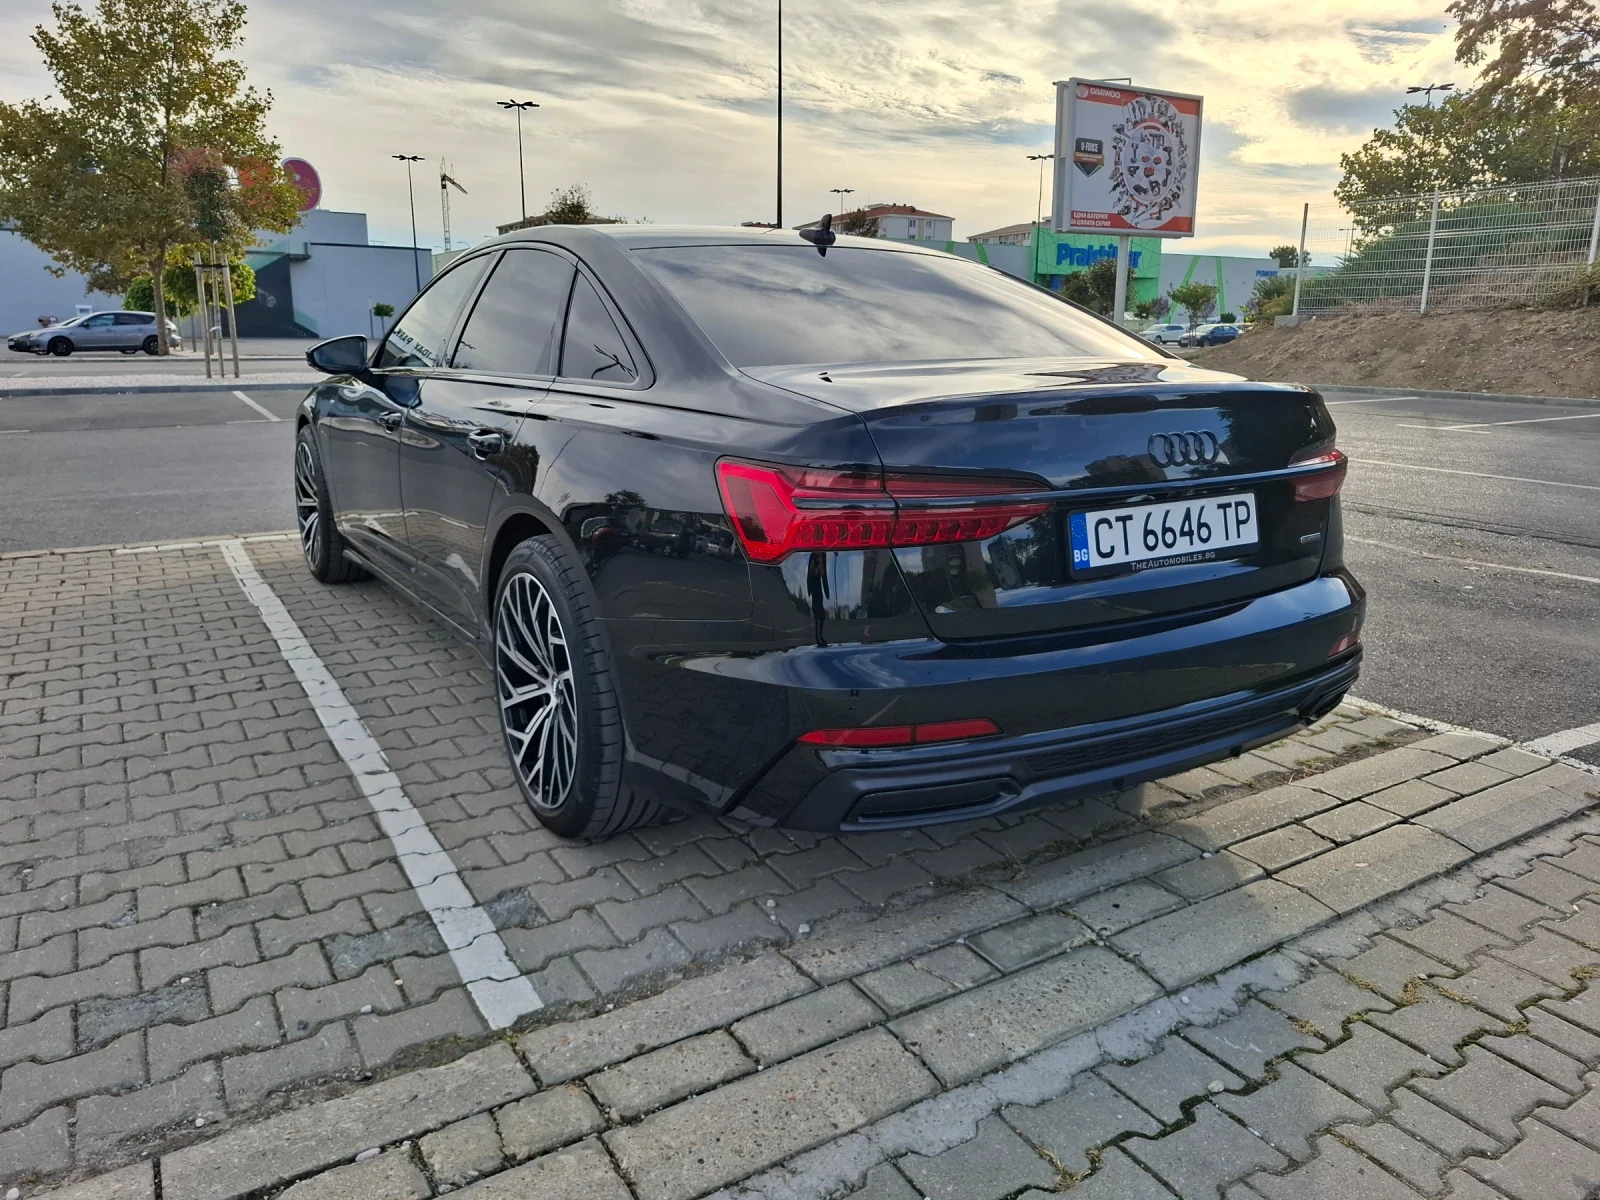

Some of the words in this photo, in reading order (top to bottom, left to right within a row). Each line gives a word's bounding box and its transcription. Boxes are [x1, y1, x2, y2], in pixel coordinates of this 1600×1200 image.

[1090, 87, 1121, 98] DAEWOO
[1080, 141, 1099, 152] U-FORCE
[1087, 212, 1109, 220] БАТЕРИЯ
[1094, 514, 1133, 559] CT
[1142, 506, 1212, 551] 6646
[1217, 500, 1251, 541] TP
[1074, 548, 1089, 563] BG
